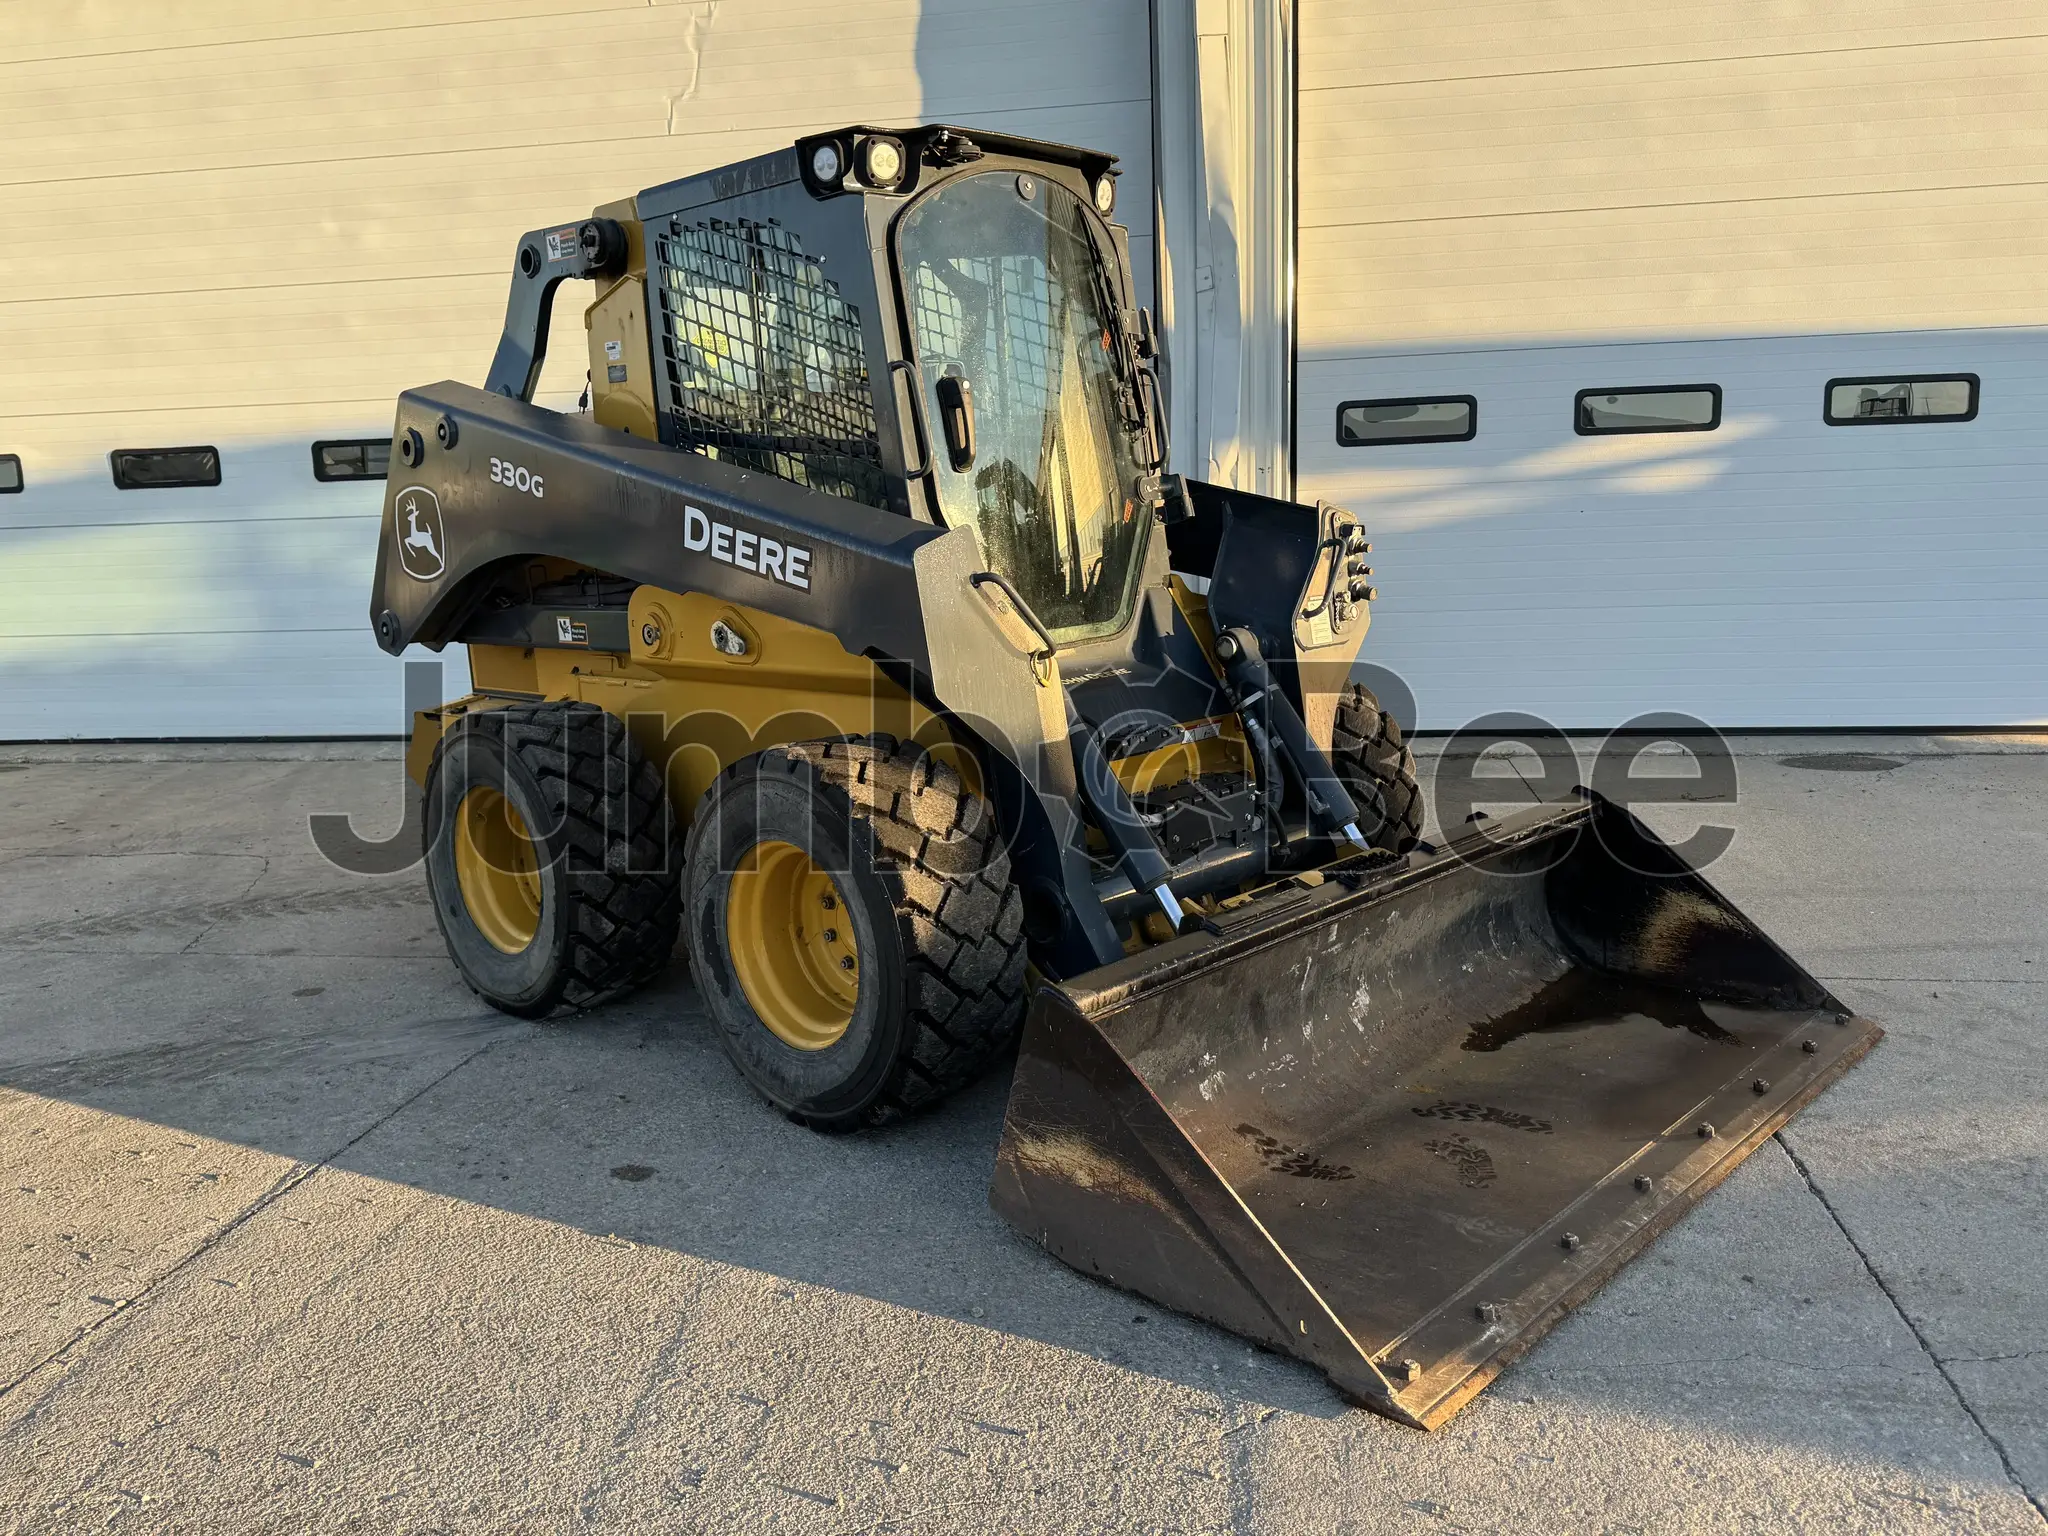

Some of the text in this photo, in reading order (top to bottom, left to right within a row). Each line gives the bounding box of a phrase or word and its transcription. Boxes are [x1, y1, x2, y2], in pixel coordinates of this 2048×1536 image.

[490, 457, 544, 498] 330G
[684, 505, 810, 589] DEERE
[1061, 668, 1132, 684] OHN DEERE
